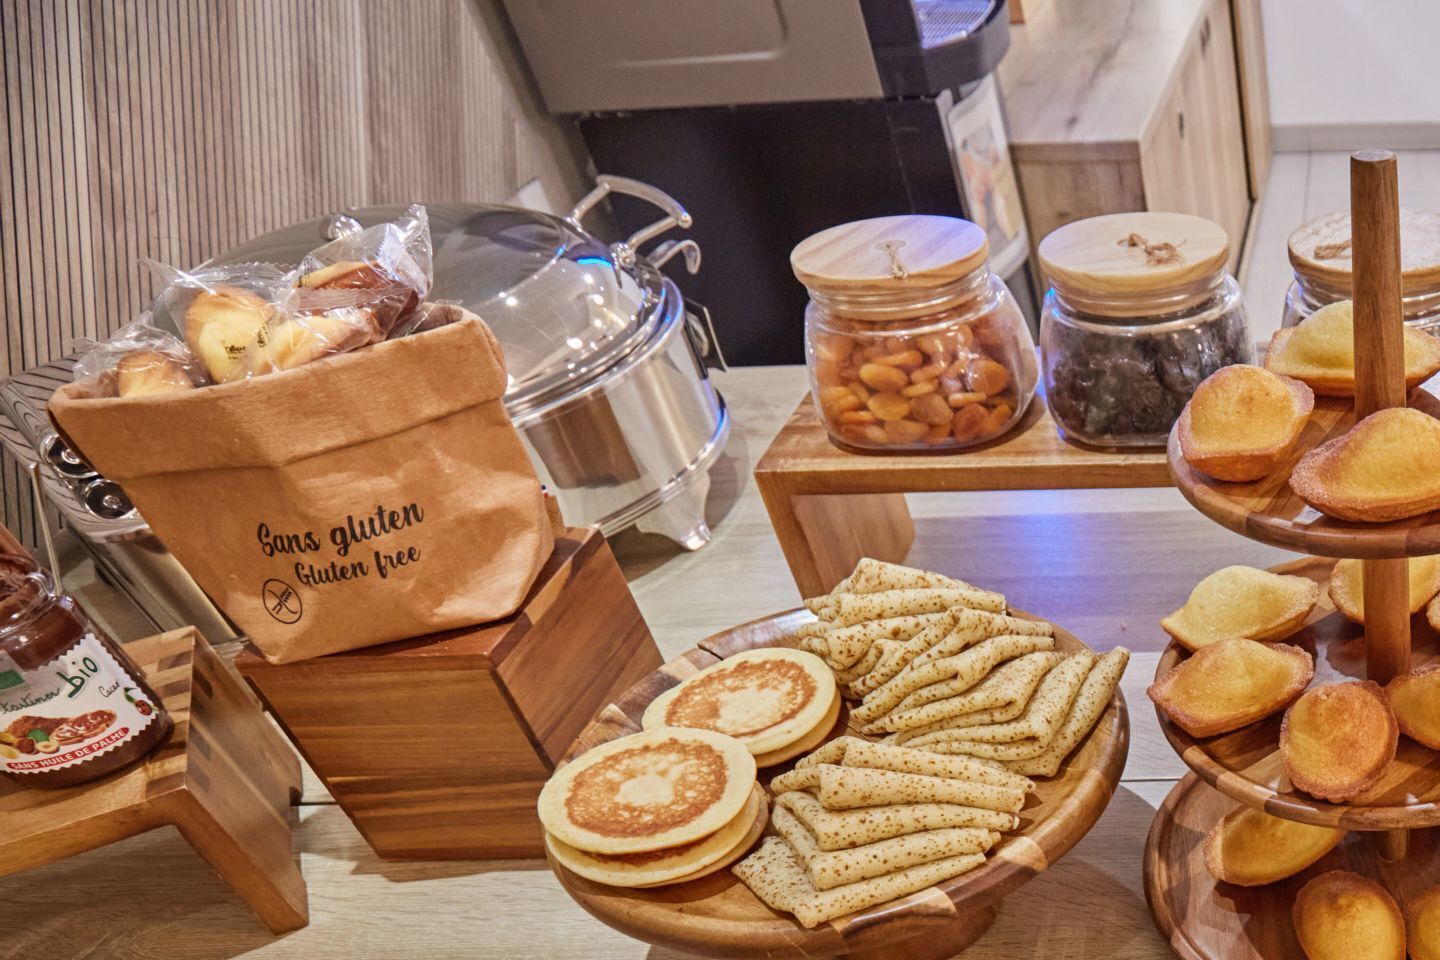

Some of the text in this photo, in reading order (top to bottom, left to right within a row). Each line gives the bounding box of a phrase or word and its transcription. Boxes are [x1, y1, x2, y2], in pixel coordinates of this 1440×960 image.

[257, 503, 424, 557] Sans gluten
[294, 546, 421, 587] Gluten free
[56, 656, 98, 698] bio
[98, 681, 121, 698] Cacao
[11, 728, 127, 770] SANS HUILE DE PALME
